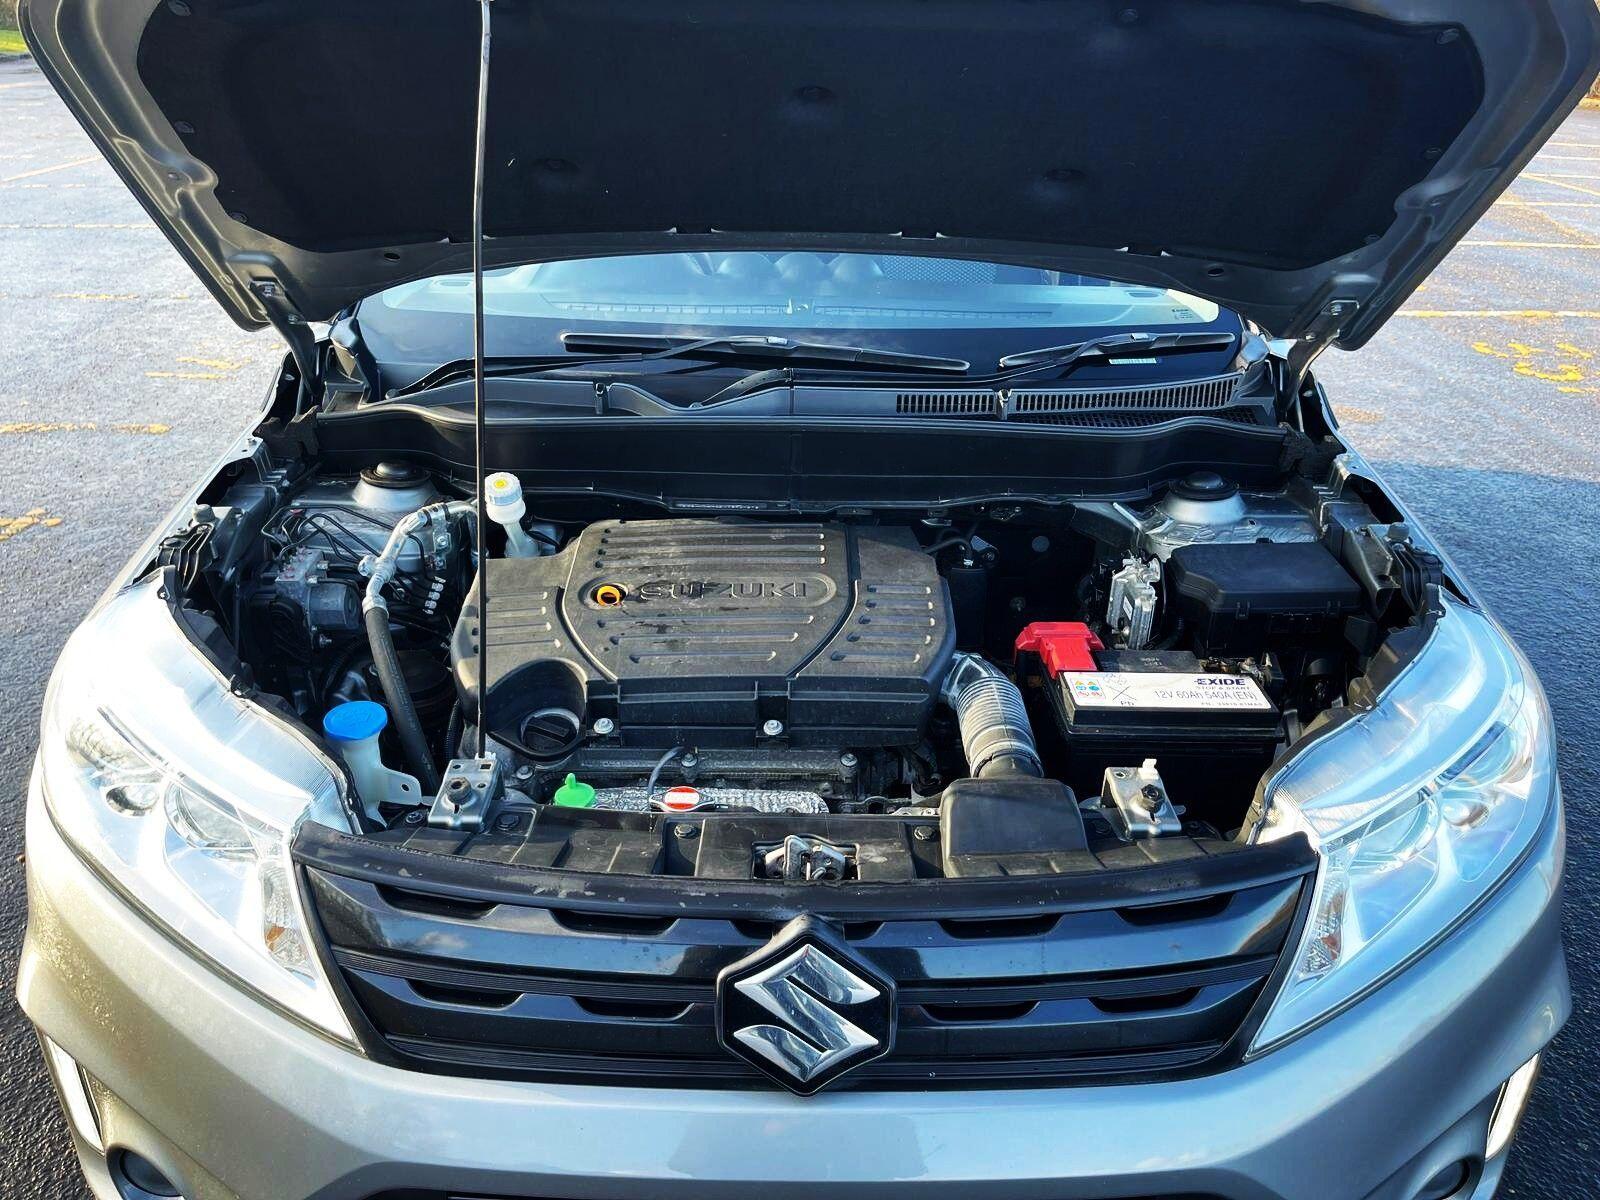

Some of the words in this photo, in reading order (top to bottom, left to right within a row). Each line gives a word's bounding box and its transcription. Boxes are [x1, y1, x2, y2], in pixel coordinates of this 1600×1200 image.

[639, 581, 808, 601] SUZUKI
[1195, 678, 1247, 686] EXIDE
[1154, 690, 1174, 699] 12V
[1175, 690, 1204, 699] 60Ah
[1204, 690, 1232, 700] 540A
[1232, 690, 1258, 701] (EN)
